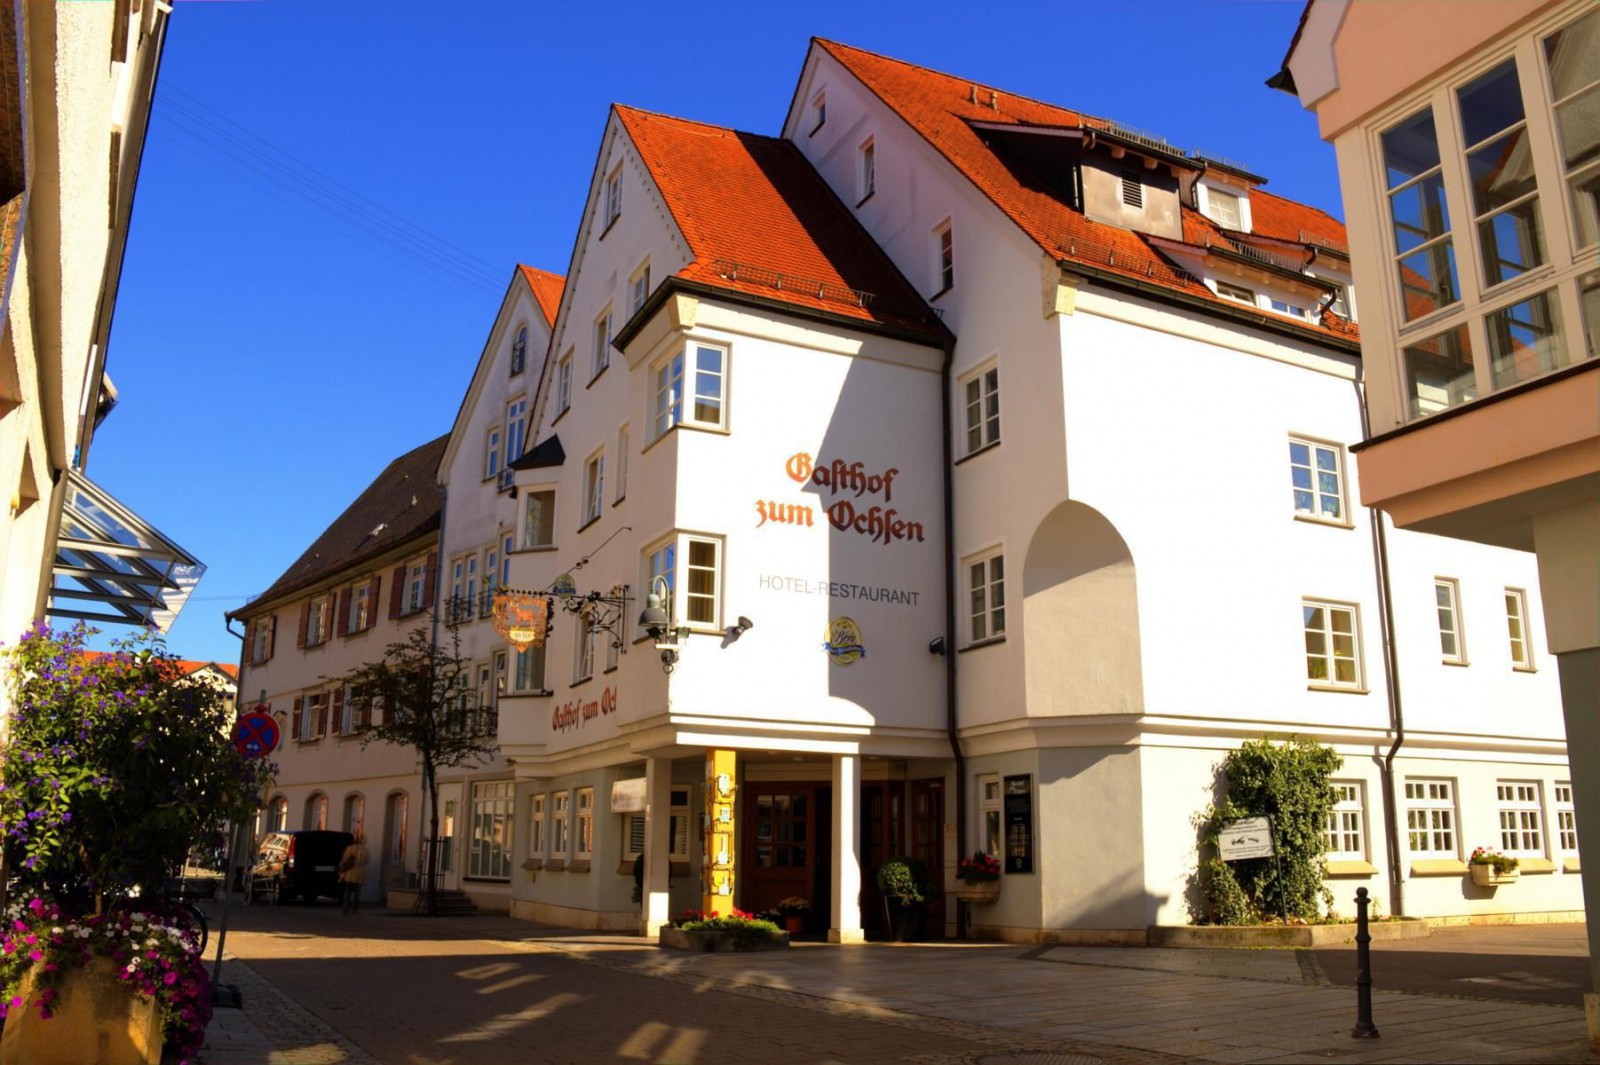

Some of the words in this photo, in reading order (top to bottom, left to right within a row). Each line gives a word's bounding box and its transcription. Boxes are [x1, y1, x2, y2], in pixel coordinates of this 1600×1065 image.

[785, 452, 898, 502] Gasthof
[755, 499, 814, 528] zum
[827, 500, 925, 545] Ochsen
[759, 574, 920, 606] HOTEL-RESTAURANT
